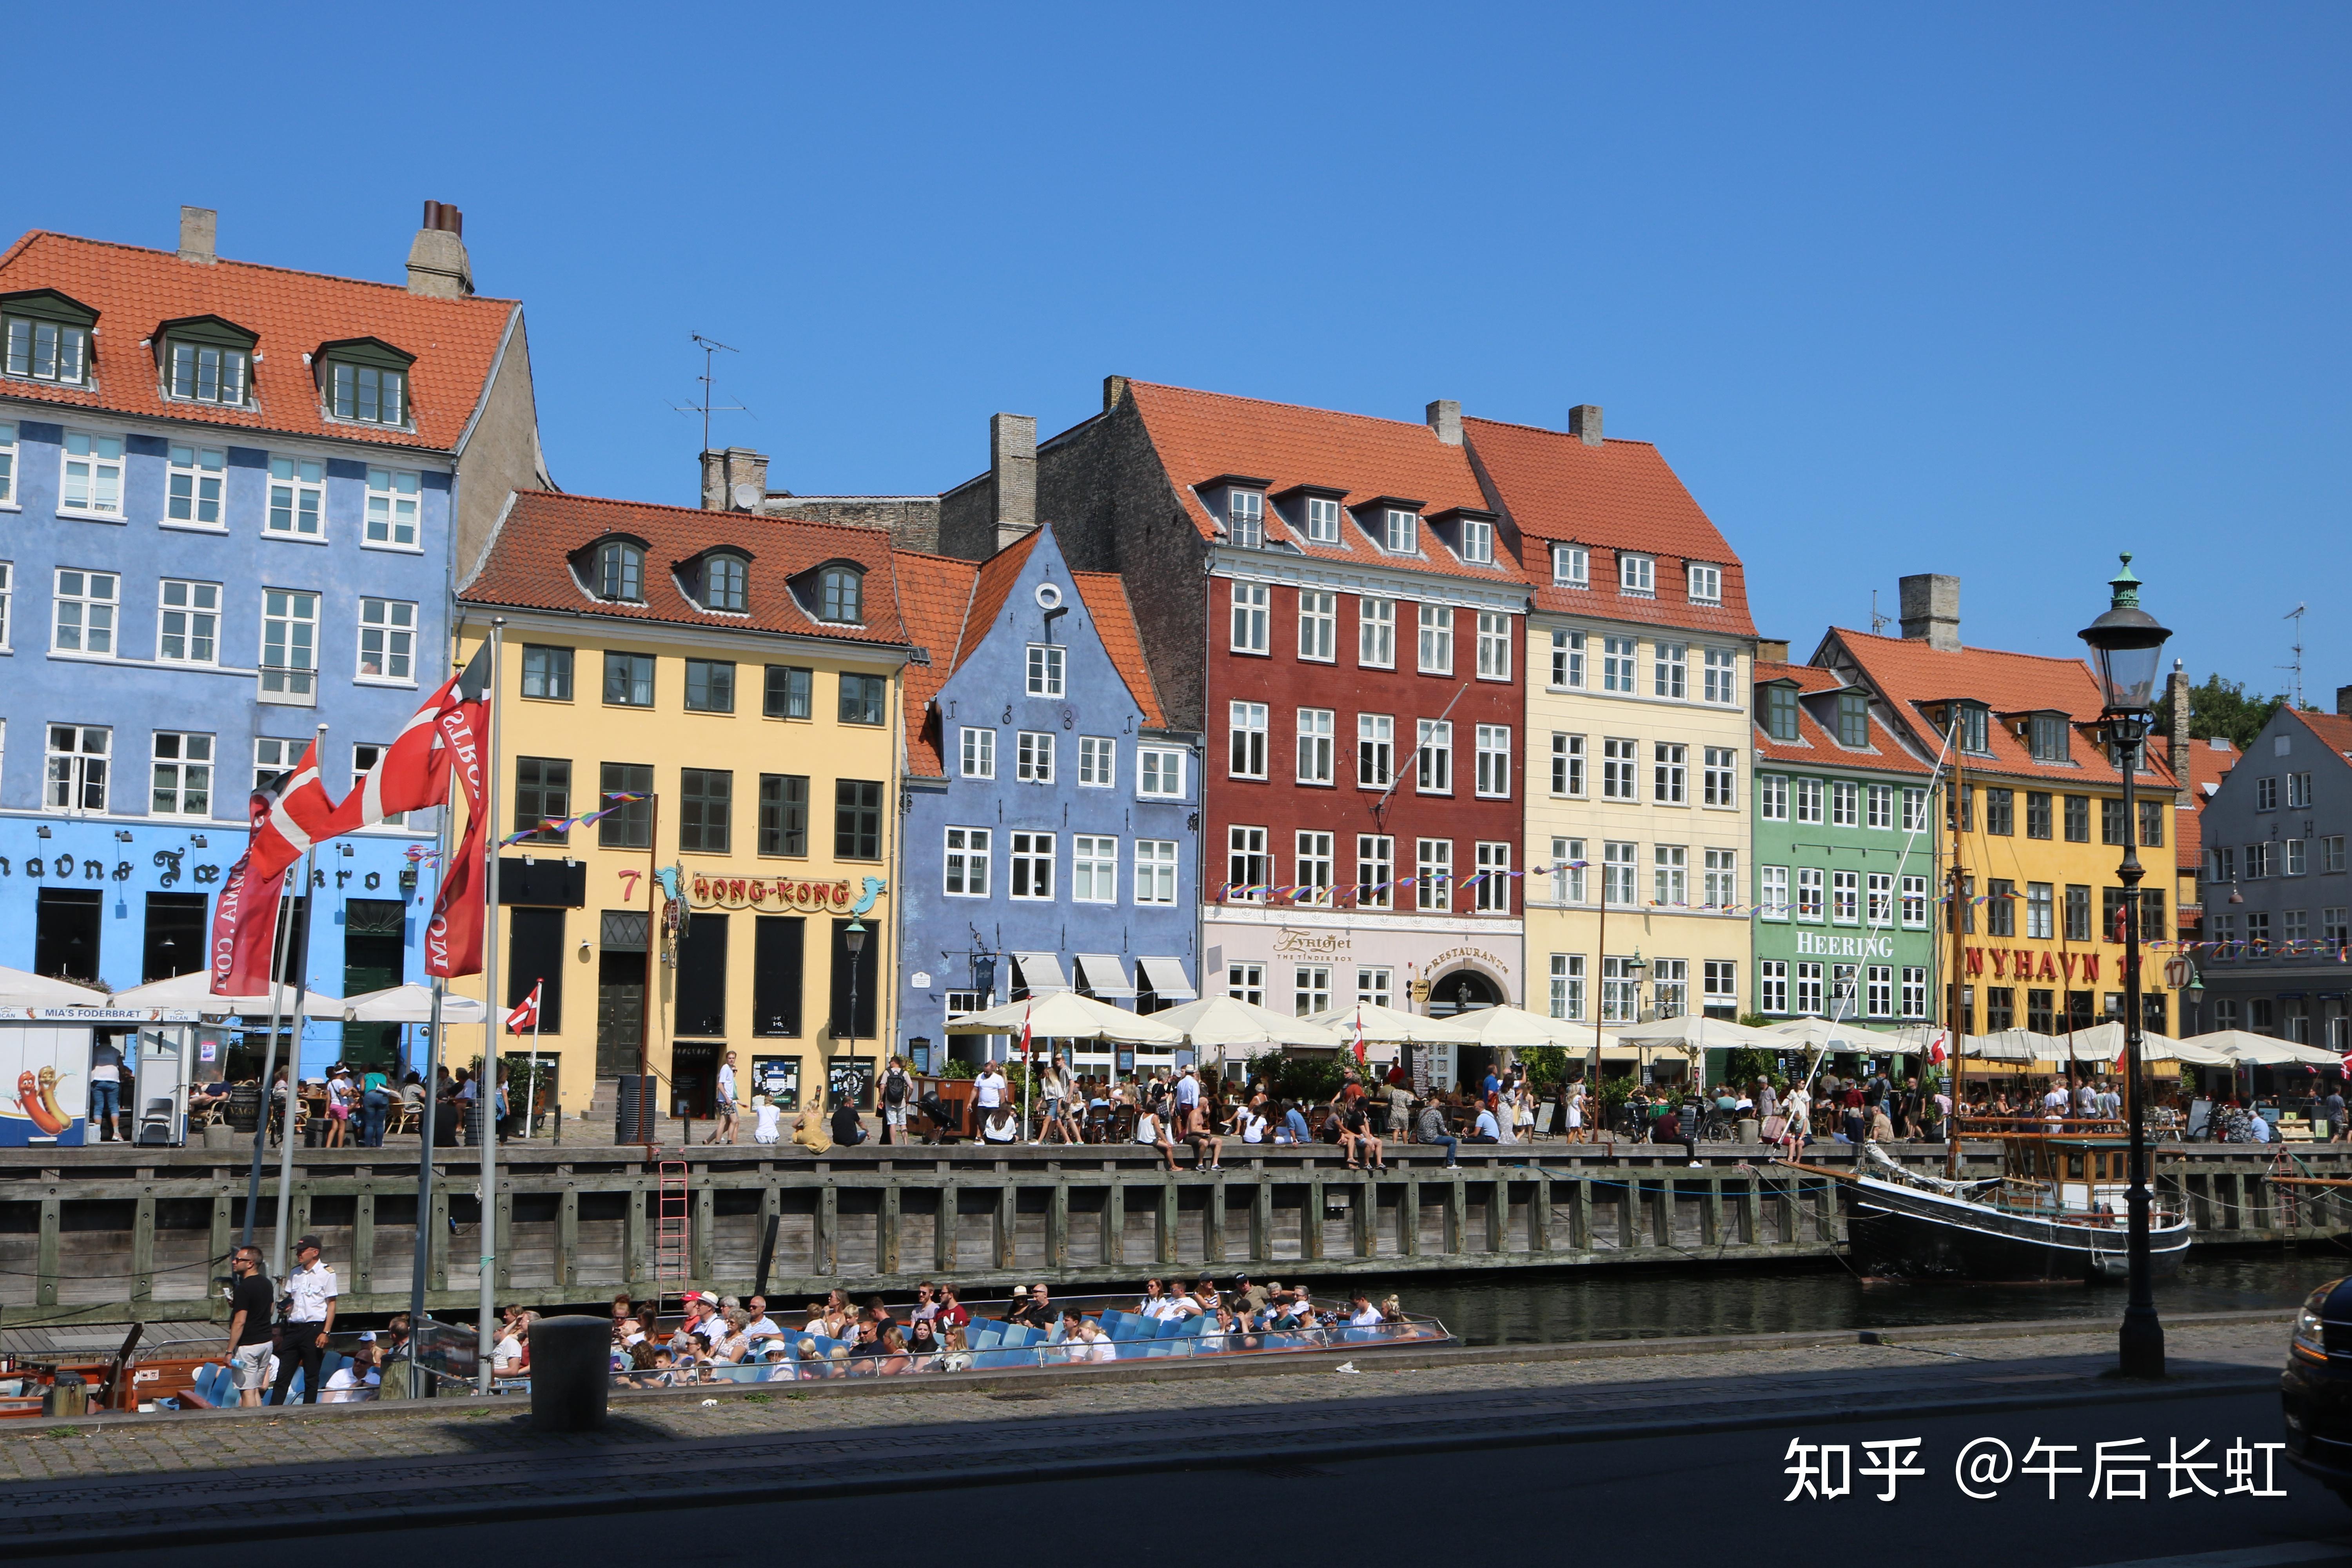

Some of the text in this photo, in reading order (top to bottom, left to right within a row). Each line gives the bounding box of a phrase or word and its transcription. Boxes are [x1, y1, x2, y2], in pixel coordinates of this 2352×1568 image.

[618, 869, 642, 902] 7
[695, 878, 850, 904] HONG-KONG
[1796, 931, 1894, 958] HEERING
[1431, 947, 1503, 969] RESTAURANT
[1965, 947, 2100, 981] NYHAVN
[2165, 961, 2185, 987] 17
